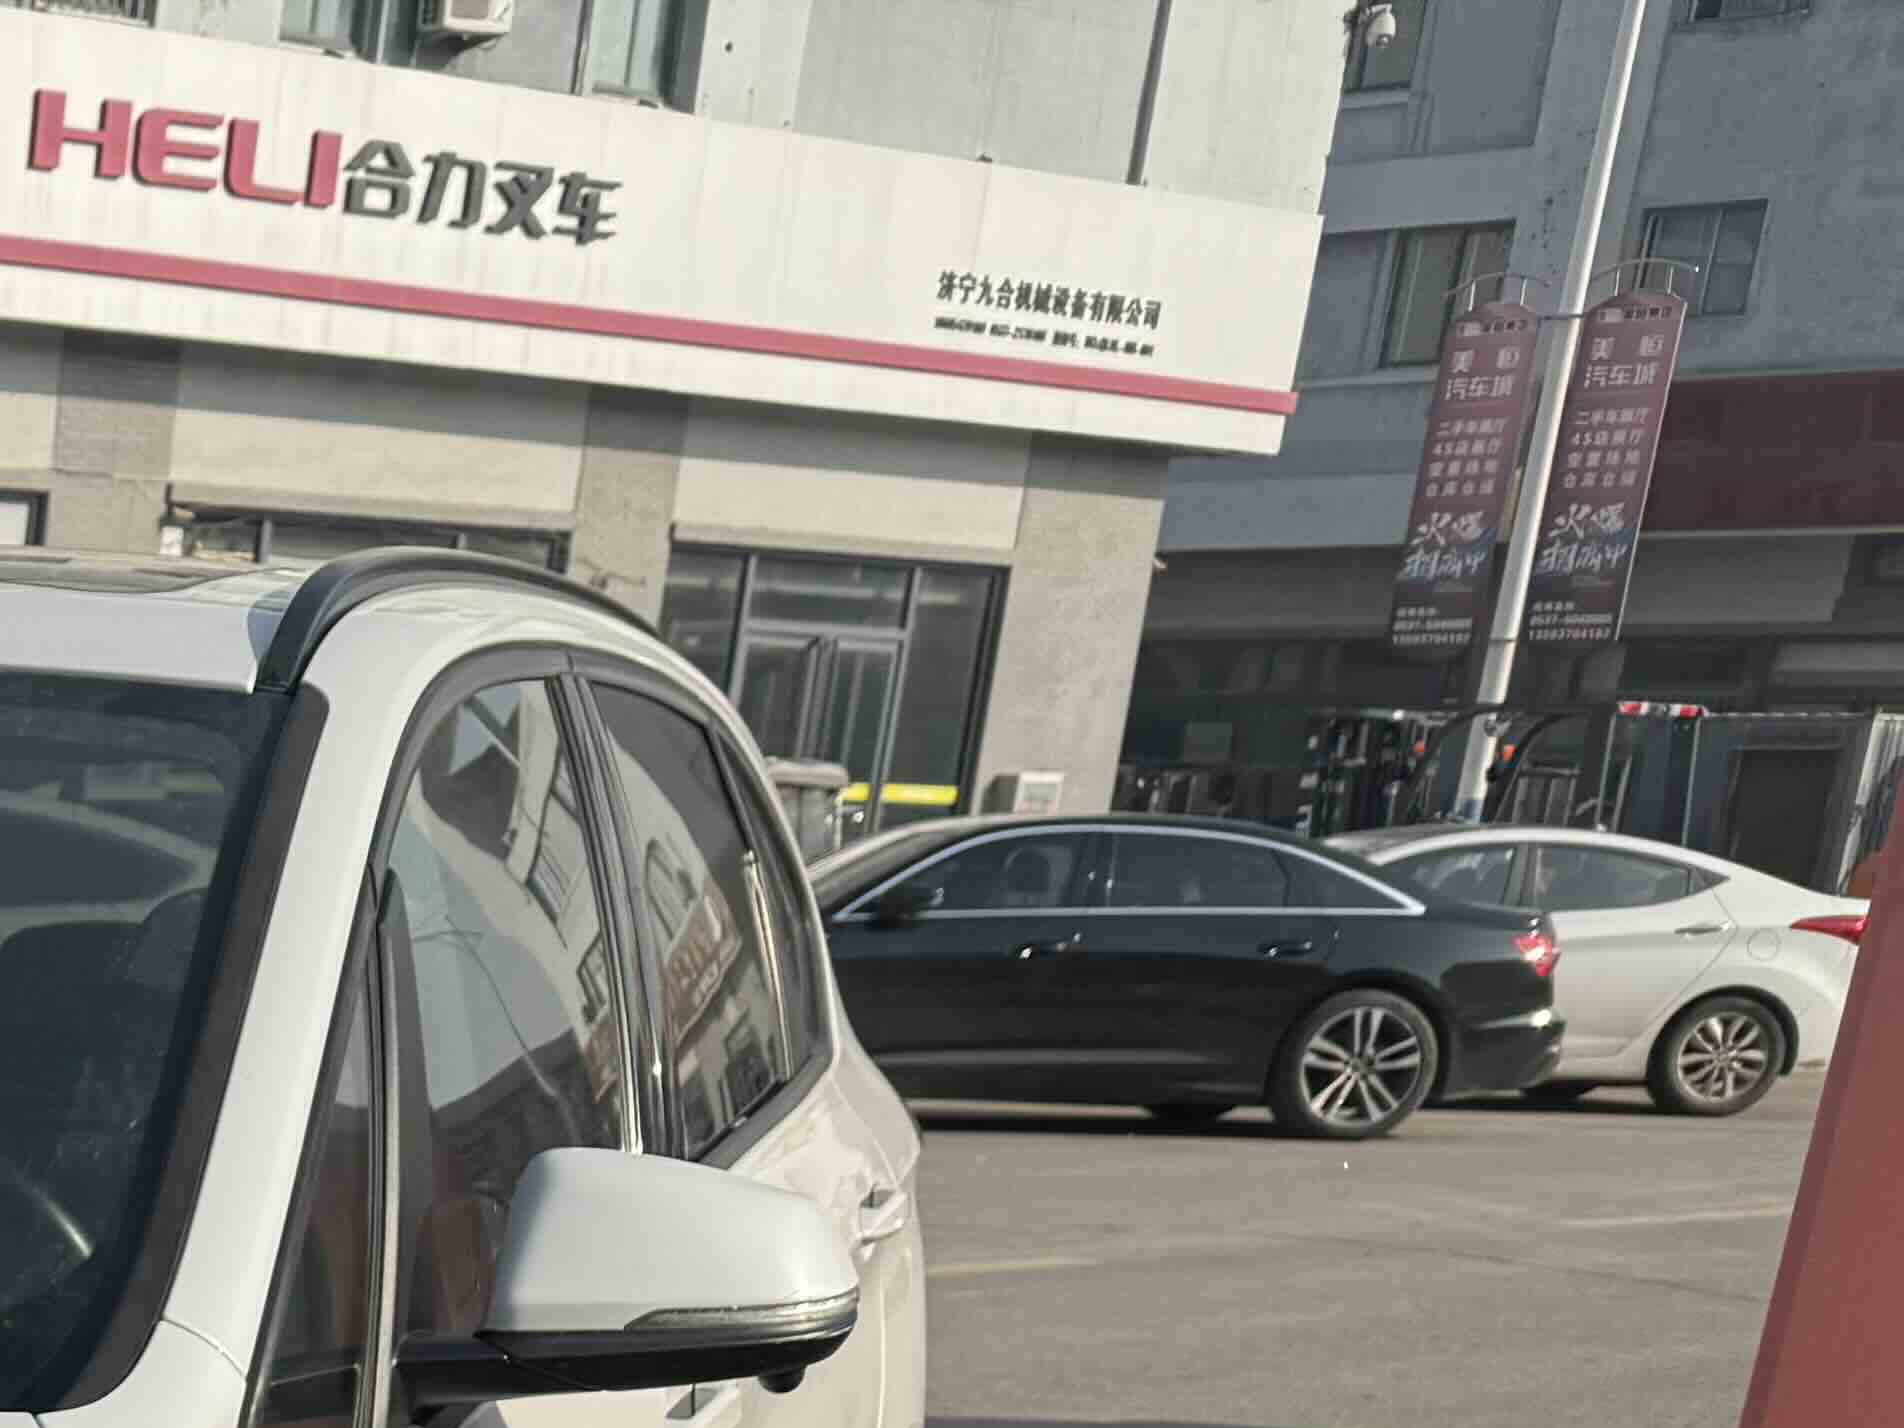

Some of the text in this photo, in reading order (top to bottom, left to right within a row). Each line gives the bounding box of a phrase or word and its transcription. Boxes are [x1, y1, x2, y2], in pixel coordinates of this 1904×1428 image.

[27, 88, 342, 208] HELI
[342, 138, 623, 246] 合力叉车
[936, 269, 1162, 331] 济宁九合机械设备有限公司
